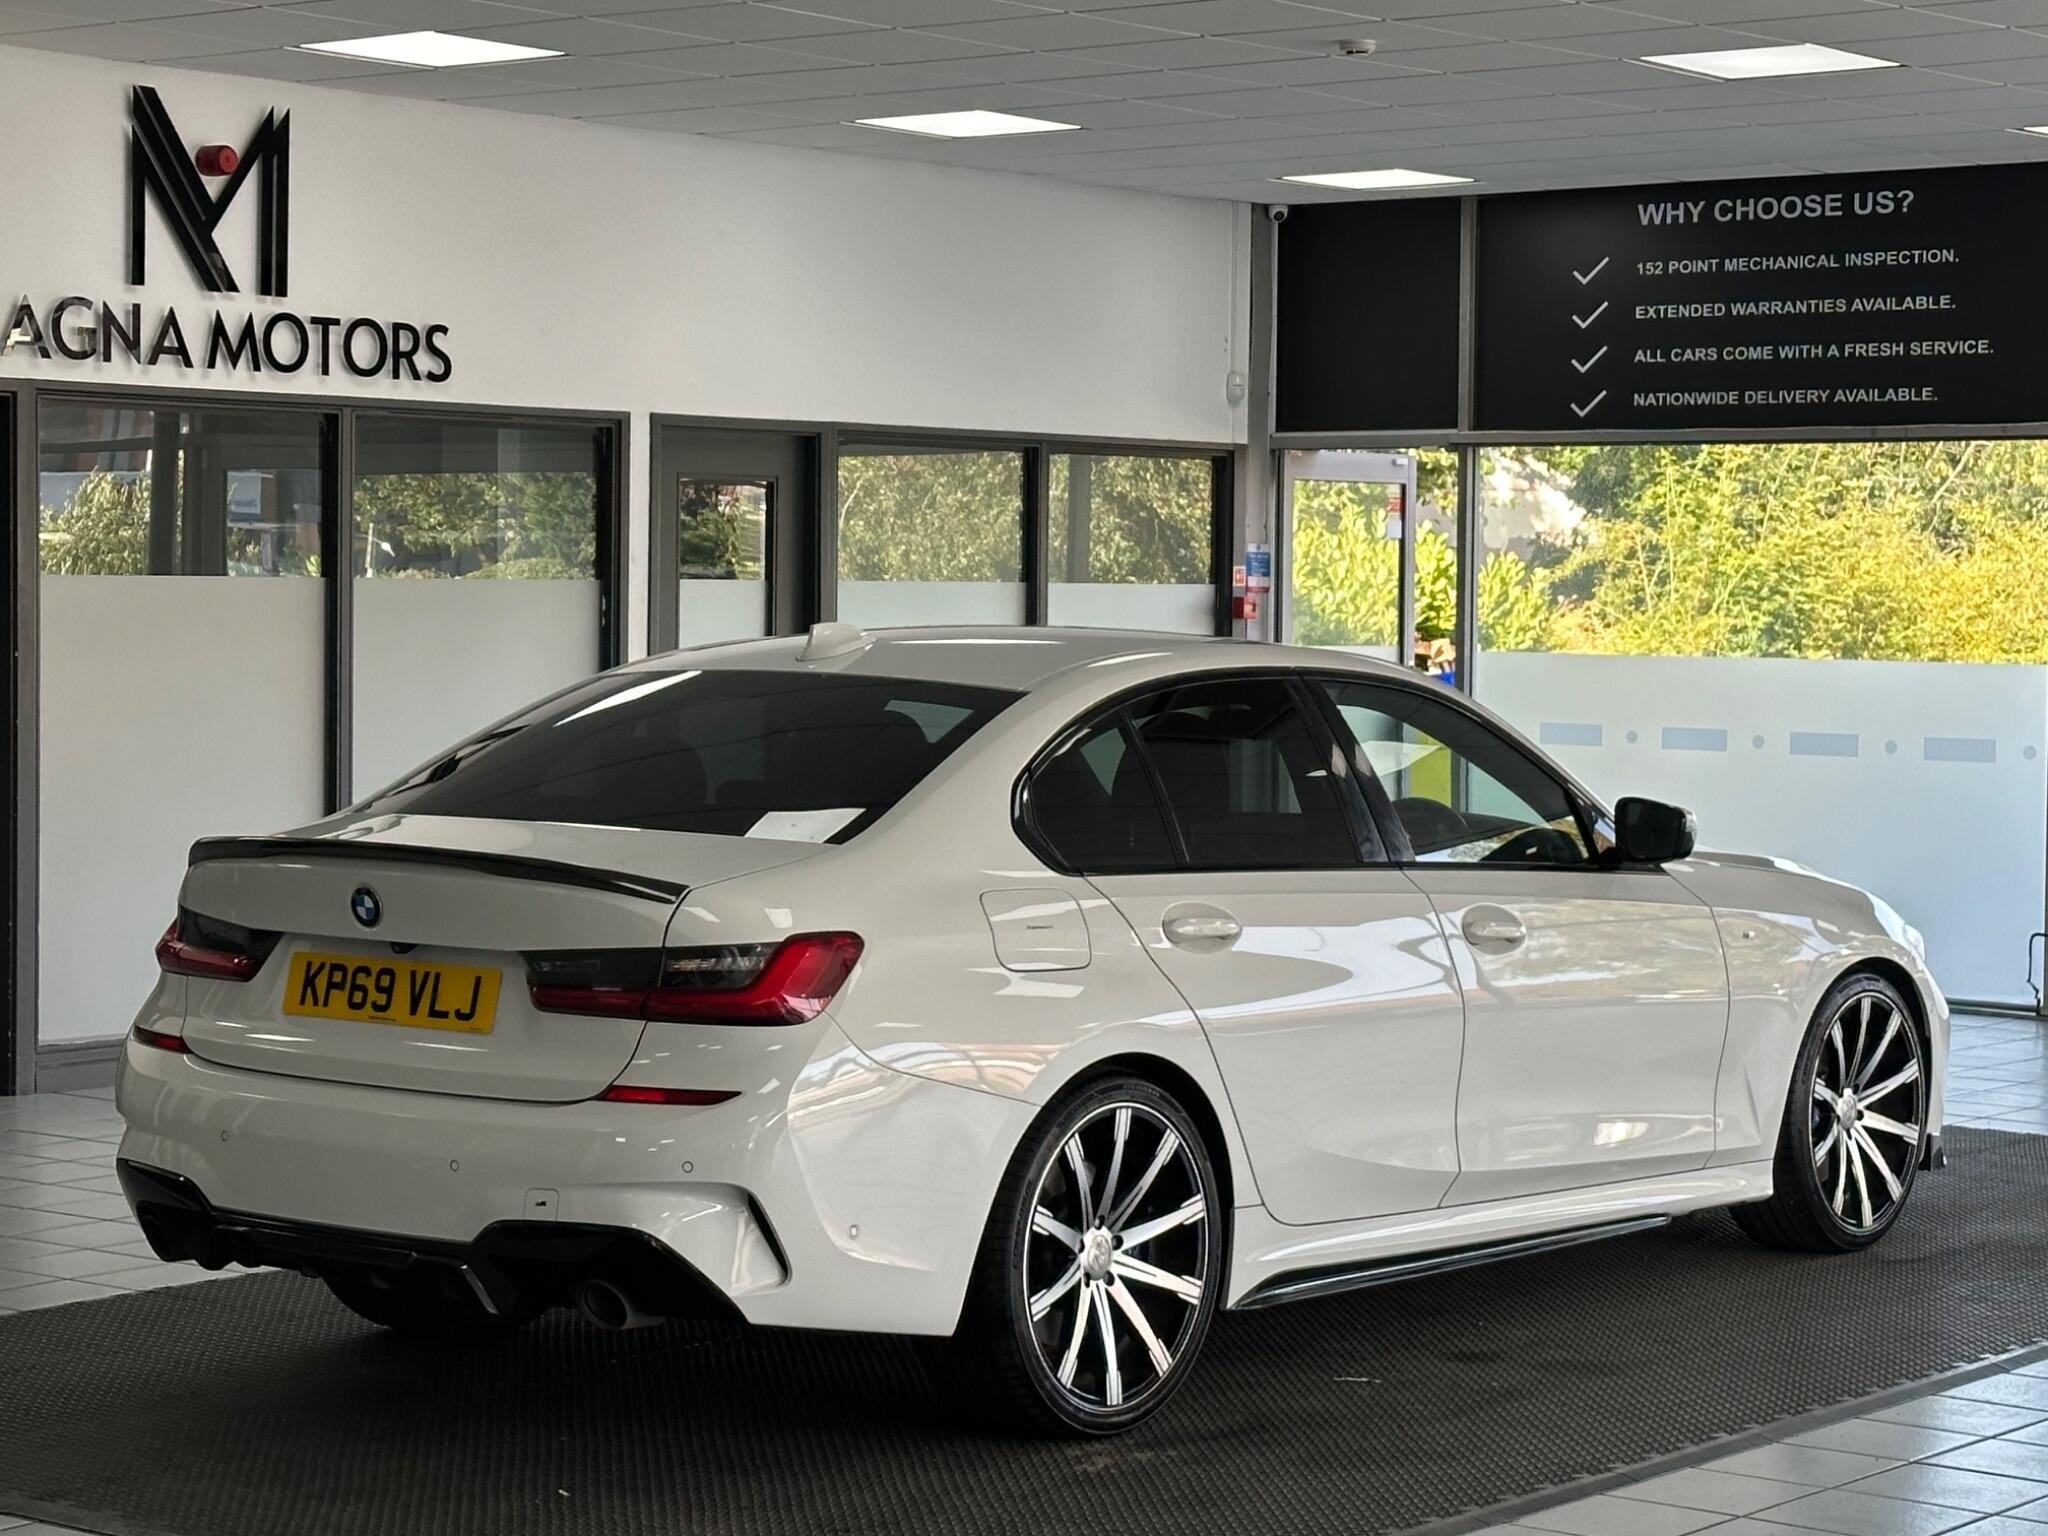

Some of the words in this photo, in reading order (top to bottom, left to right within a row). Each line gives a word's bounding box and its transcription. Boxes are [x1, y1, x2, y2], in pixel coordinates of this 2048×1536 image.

[1637, 201, 1706, 226] WHY
[1714, 194, 1843, 222] CHOOSE
[1854, 190, 1914, 215] US?
[1636, 261, 1664, 276] 152
[1668, 258, 1720, 275] POINT
[1724, 255, 1840, 272] MECHANICAL
[1845, 249, 1960, 267] INSPECTION.
[1635, 303, 1726, 320] EXTENDED
[1730, 299, 1847, 316] WARRANTIES
[1850, 295, 1957, 312] AVAILABLE.
[0, 294, 194, 368] AGNA
[206, 309, 453, 384] MOTORS
[1633, 349, 1666, 363] ALL
[1670, 347, 1719, 362] CARS
[1722, 346, 1774, 361] COME
[1778, 345, 1823, 360] WITH
[1826, 345, 1840, 358] A
[1844, 342, 1904, 357] FRESH
[1909, 340, 1994, 356] SERVICE.
[1633, 391, 1739, 407] NATIONWIDE
[1744, 389, 1830, 404] DELIVERY
[1833, 388, 1938, 403] AVAILABLE.
[299, 961, 396, 1013] KP69
[409, 969, 483, 1022] VLJ
